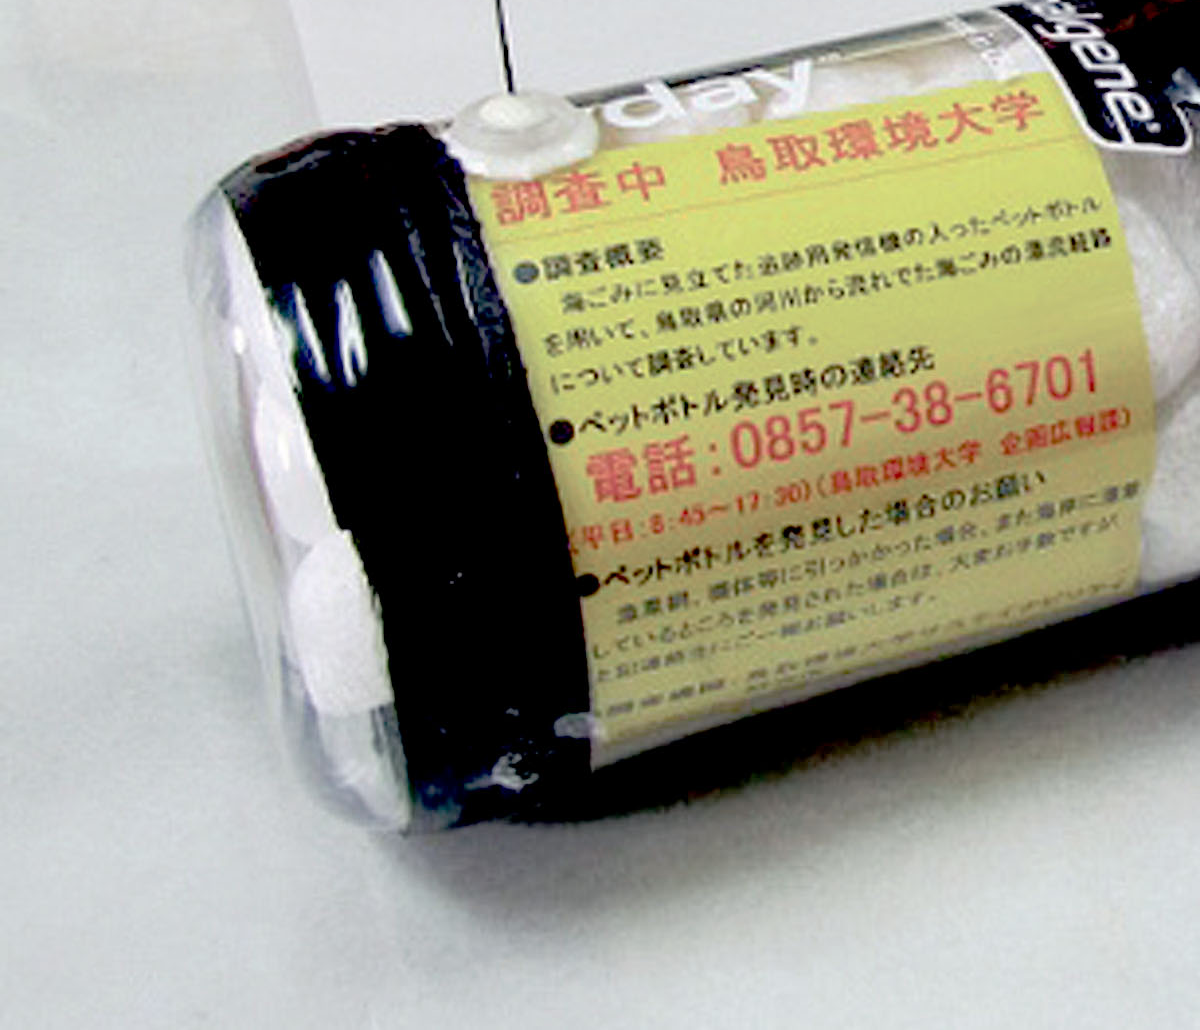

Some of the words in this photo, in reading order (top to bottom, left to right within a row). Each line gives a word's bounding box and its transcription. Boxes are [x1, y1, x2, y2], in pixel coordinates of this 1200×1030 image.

[492, 160, 667, 226] 調査中
[715, 90, 1045, 185] 鳥取環境大学
